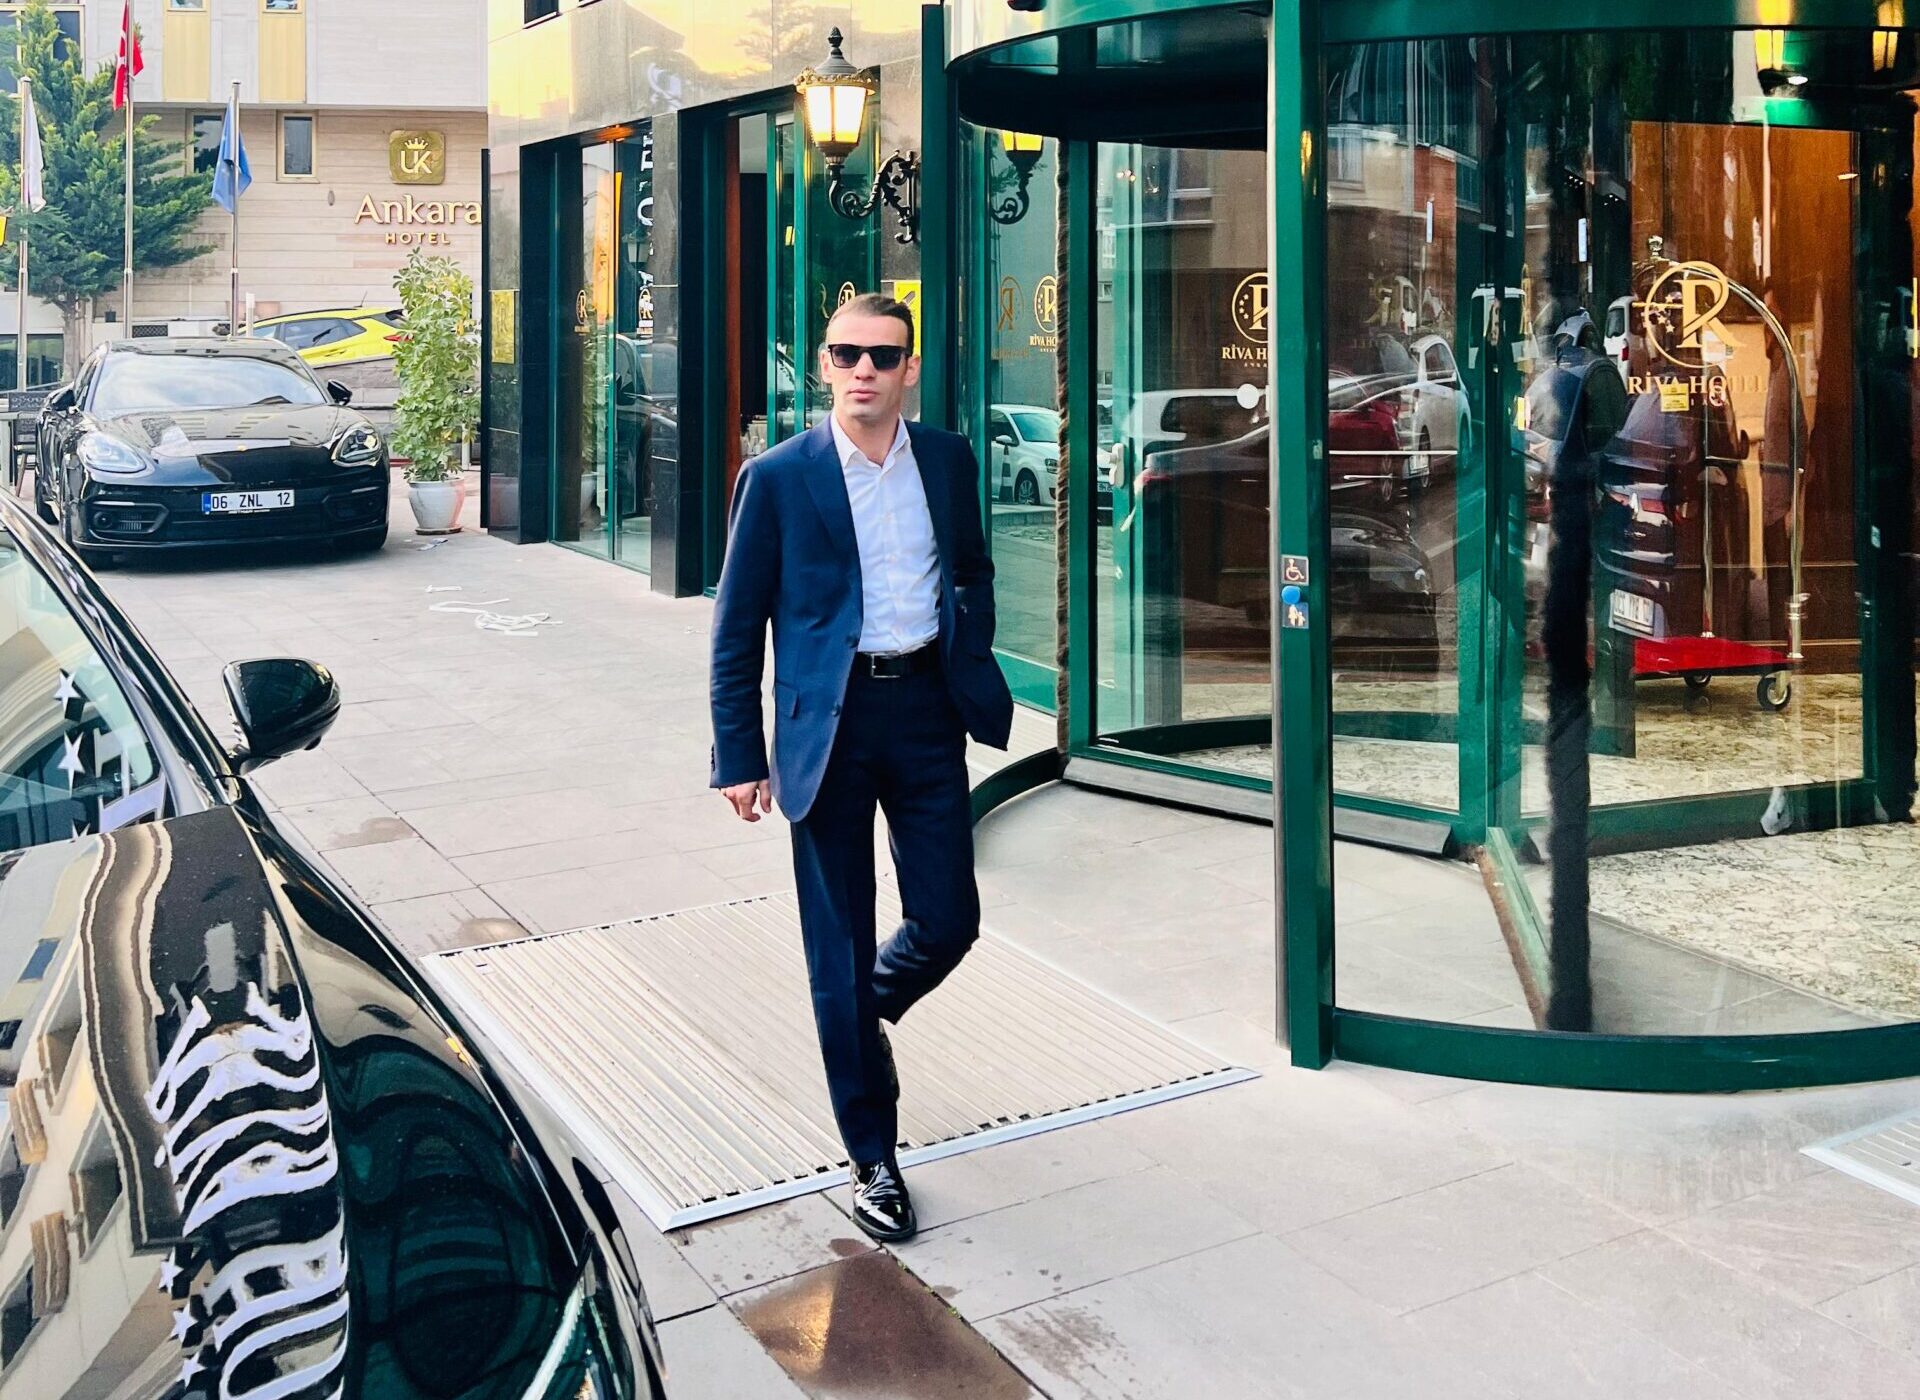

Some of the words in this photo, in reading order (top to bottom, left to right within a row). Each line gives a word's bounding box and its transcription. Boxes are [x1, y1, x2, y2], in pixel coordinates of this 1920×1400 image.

[400, 150, 433, 174] UK
[354, 192, 482, 225] Ankara
[385, 232, 451, 245] HOTEL
[212, 496, 228, 510] 06
[239, 494, 264, 508] ZNL
[277, 492, 291, 506] 12
